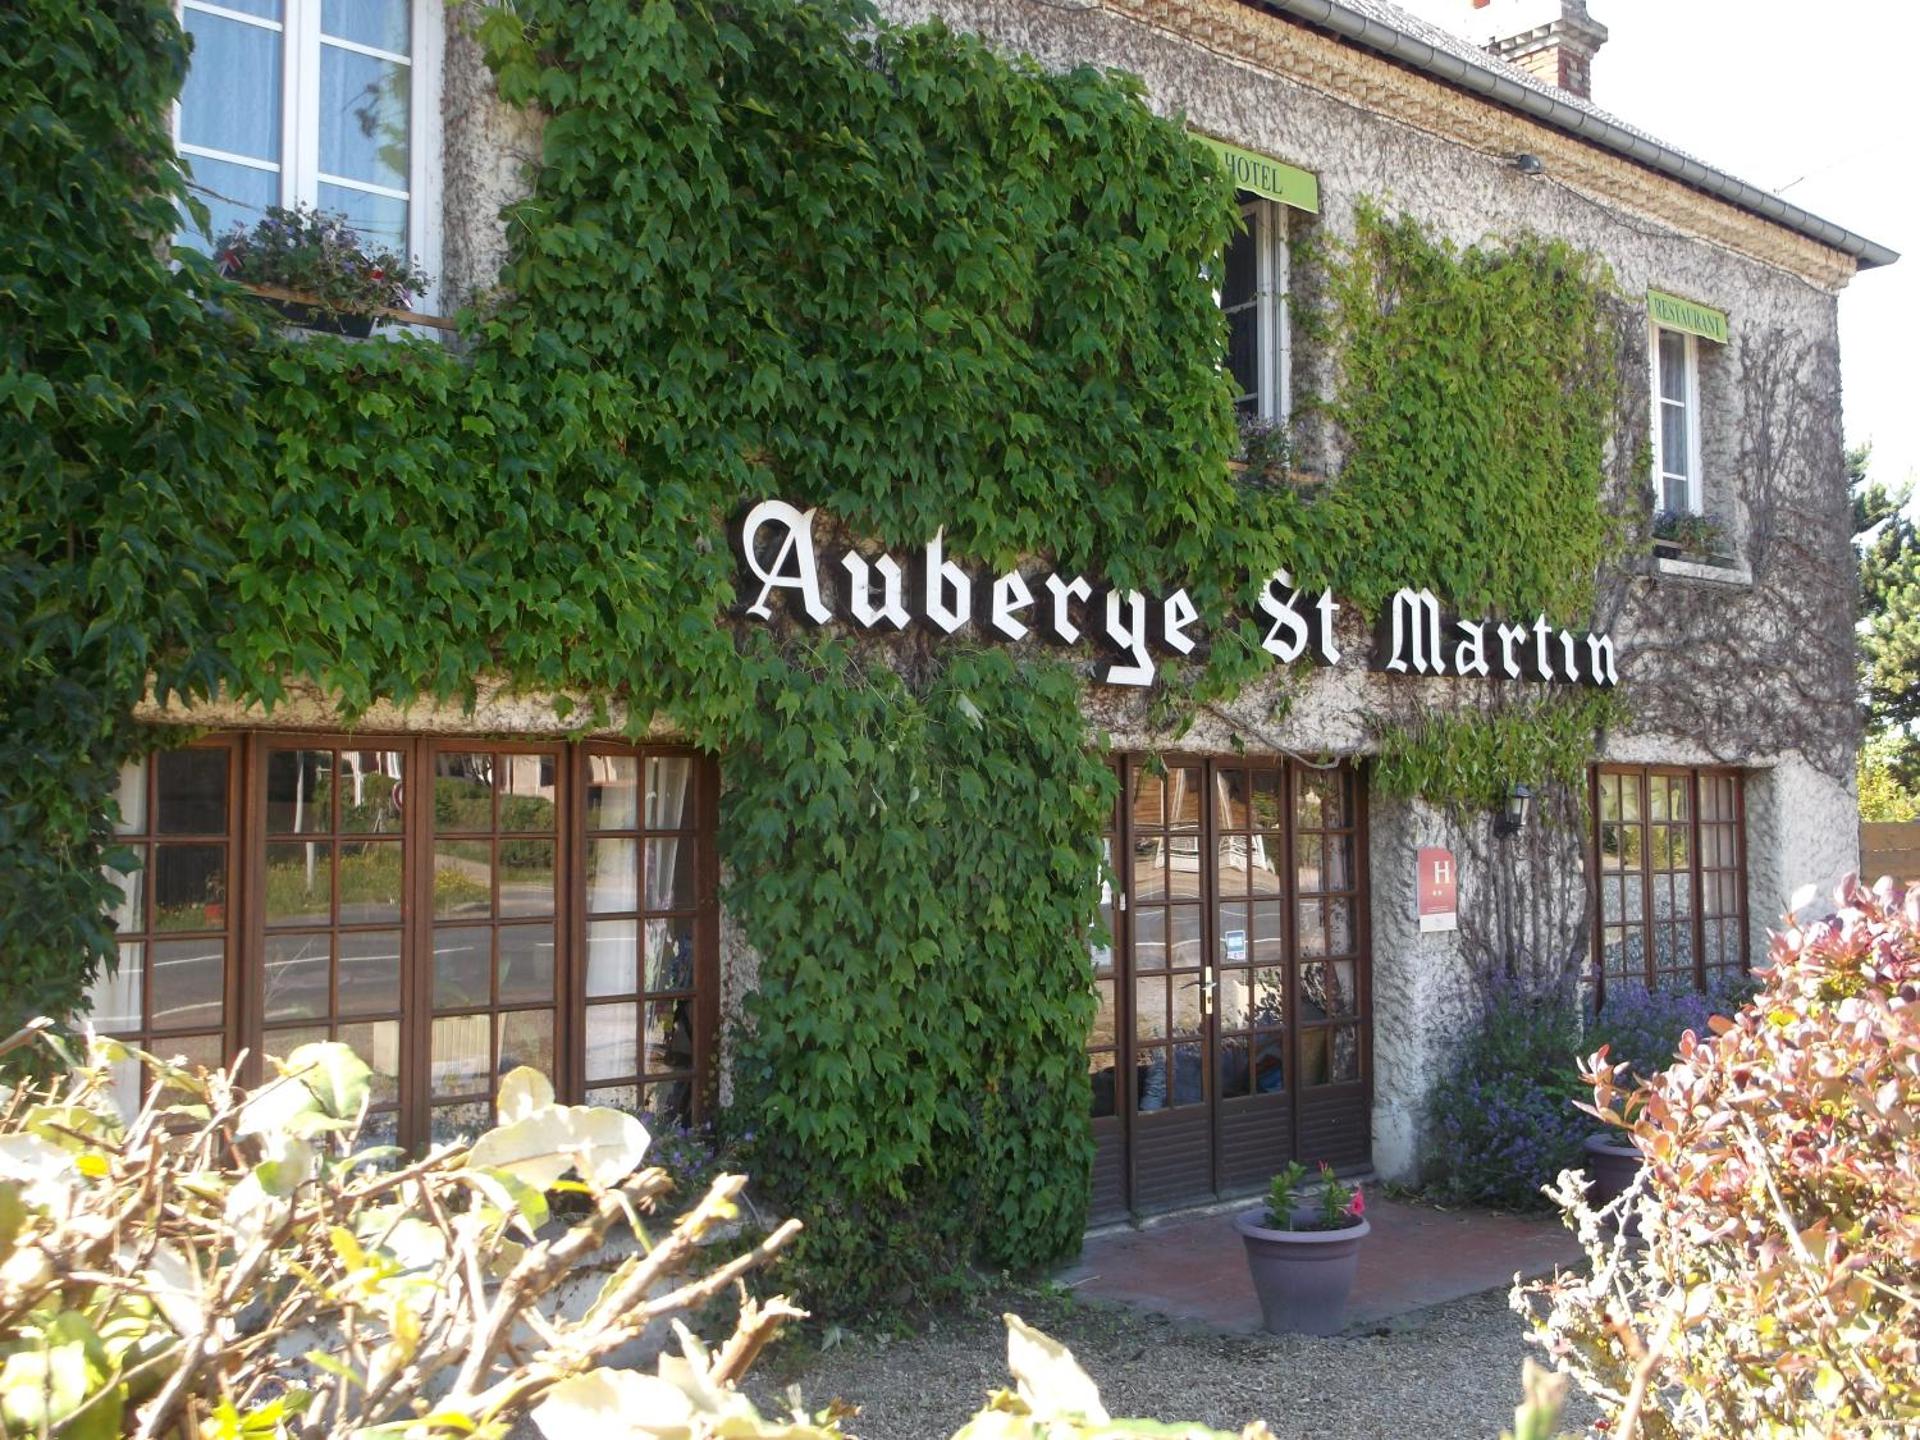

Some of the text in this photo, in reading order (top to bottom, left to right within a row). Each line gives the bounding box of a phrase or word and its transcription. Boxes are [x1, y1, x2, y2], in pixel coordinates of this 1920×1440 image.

[1224, 151, 1283, 195] HOTEL
[1654, 298, 1720, 337] RESTAURANT
[742, 499, 1620, 687] Auberge St Martin
[1433, 860, 1450, 885] H
